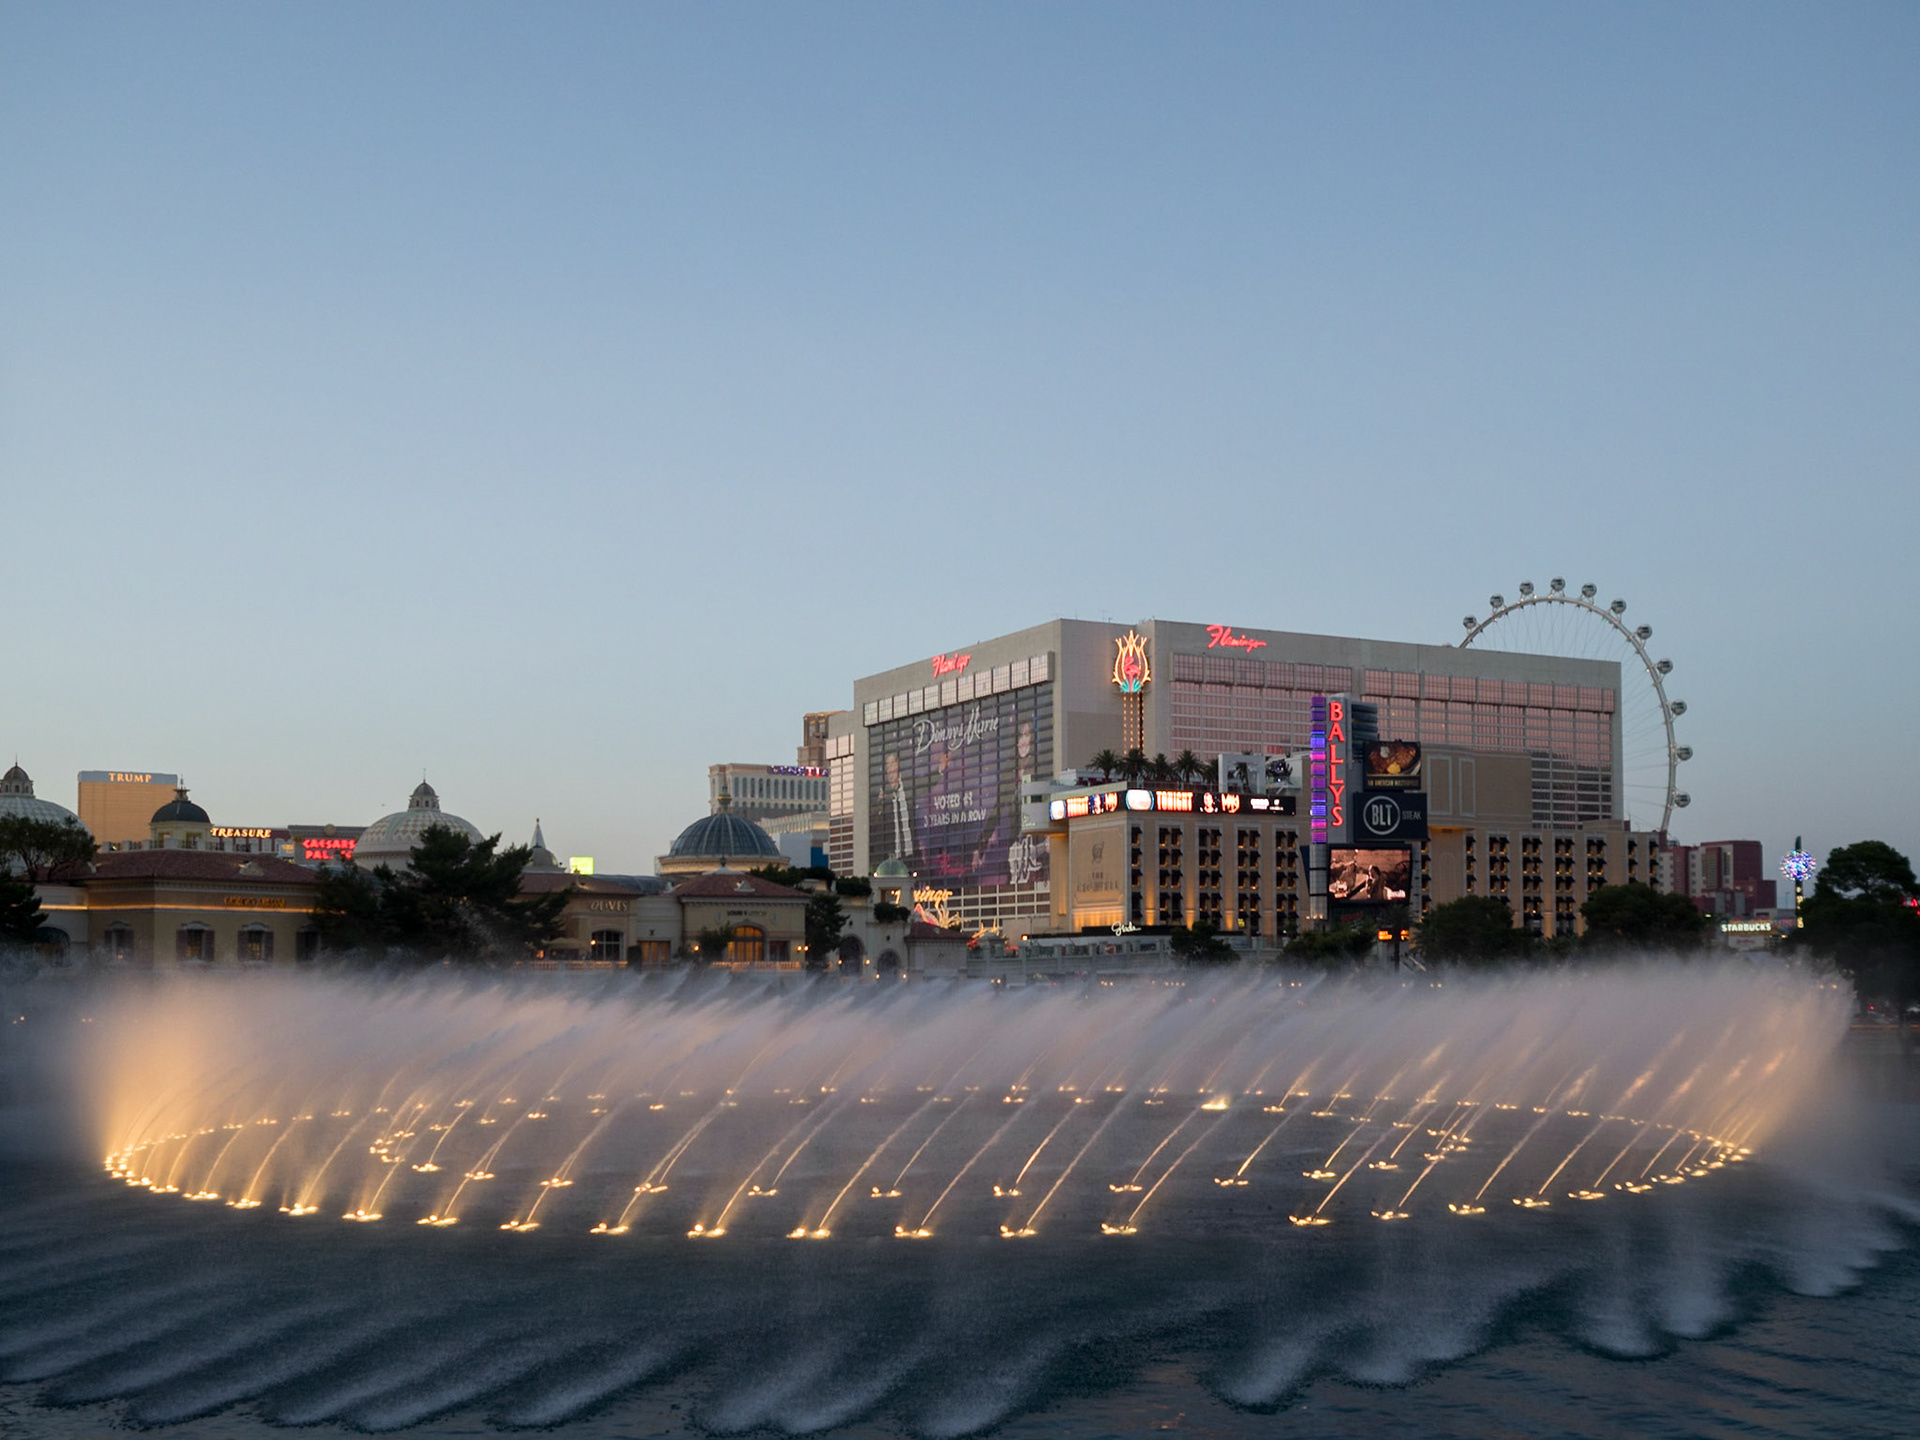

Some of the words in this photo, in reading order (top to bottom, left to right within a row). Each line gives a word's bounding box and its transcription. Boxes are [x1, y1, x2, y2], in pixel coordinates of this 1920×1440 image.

[1206, 624, 1267, 654] Flamingo
[108, 772, 152, 783] TRUMP
[934, 793, 961, 810] VOTED
[1155, 790, 1194, 812] TONIGHT
[929, 812, 951, 826] YEARS
[951, 811, 960, 824] IN
[968, 808, 987, 822] ROW
[1371, 804, 1392, 826] BLT
[1402, 811, 1421, 821] STEAK
[211, 827, 272, 839] TREASURE
[302, 838, 356, 850] CAESARS
[1721, 923, 1772, 933] STARBUCKS
